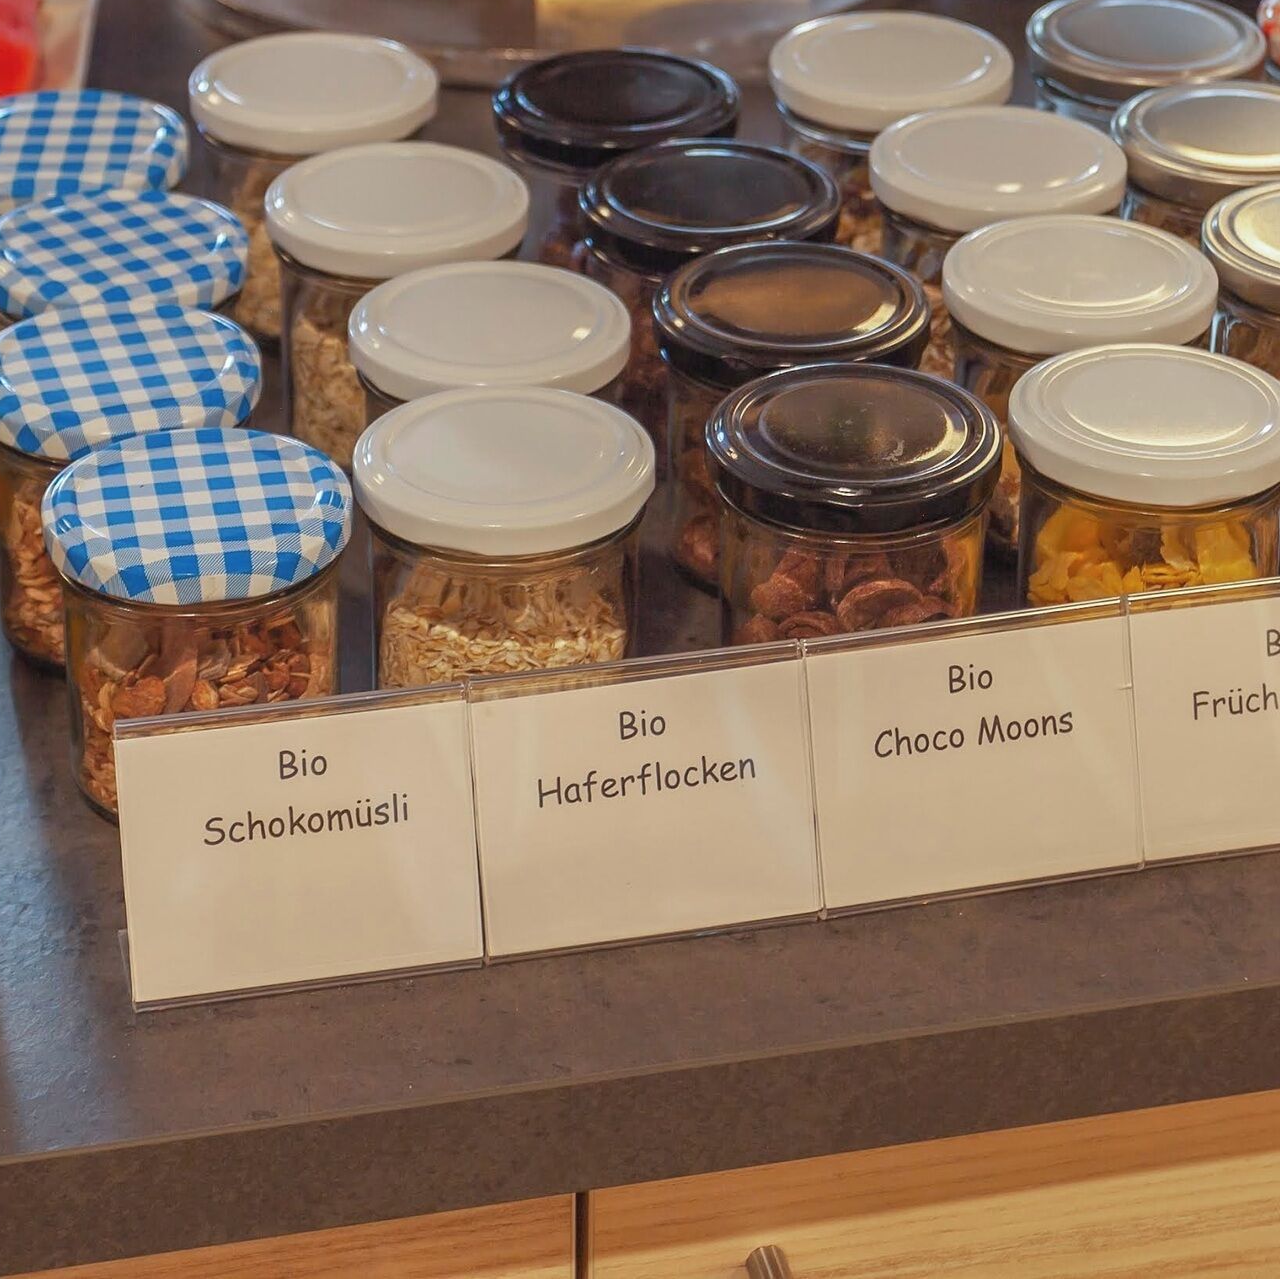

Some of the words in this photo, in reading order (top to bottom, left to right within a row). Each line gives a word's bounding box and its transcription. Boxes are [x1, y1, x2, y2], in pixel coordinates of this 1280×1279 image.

[948, 663, 994, 695] Bio
[619, 709, 667, 741] Bio
[874, 726, 965, 758] Choco
[977, 711, 1075, 746] Moons
[278, 748, 328, 780] Bio
[536, 752, 757, 809] Haferflocken
[203, 792, 410, 846] Schokomüsli
